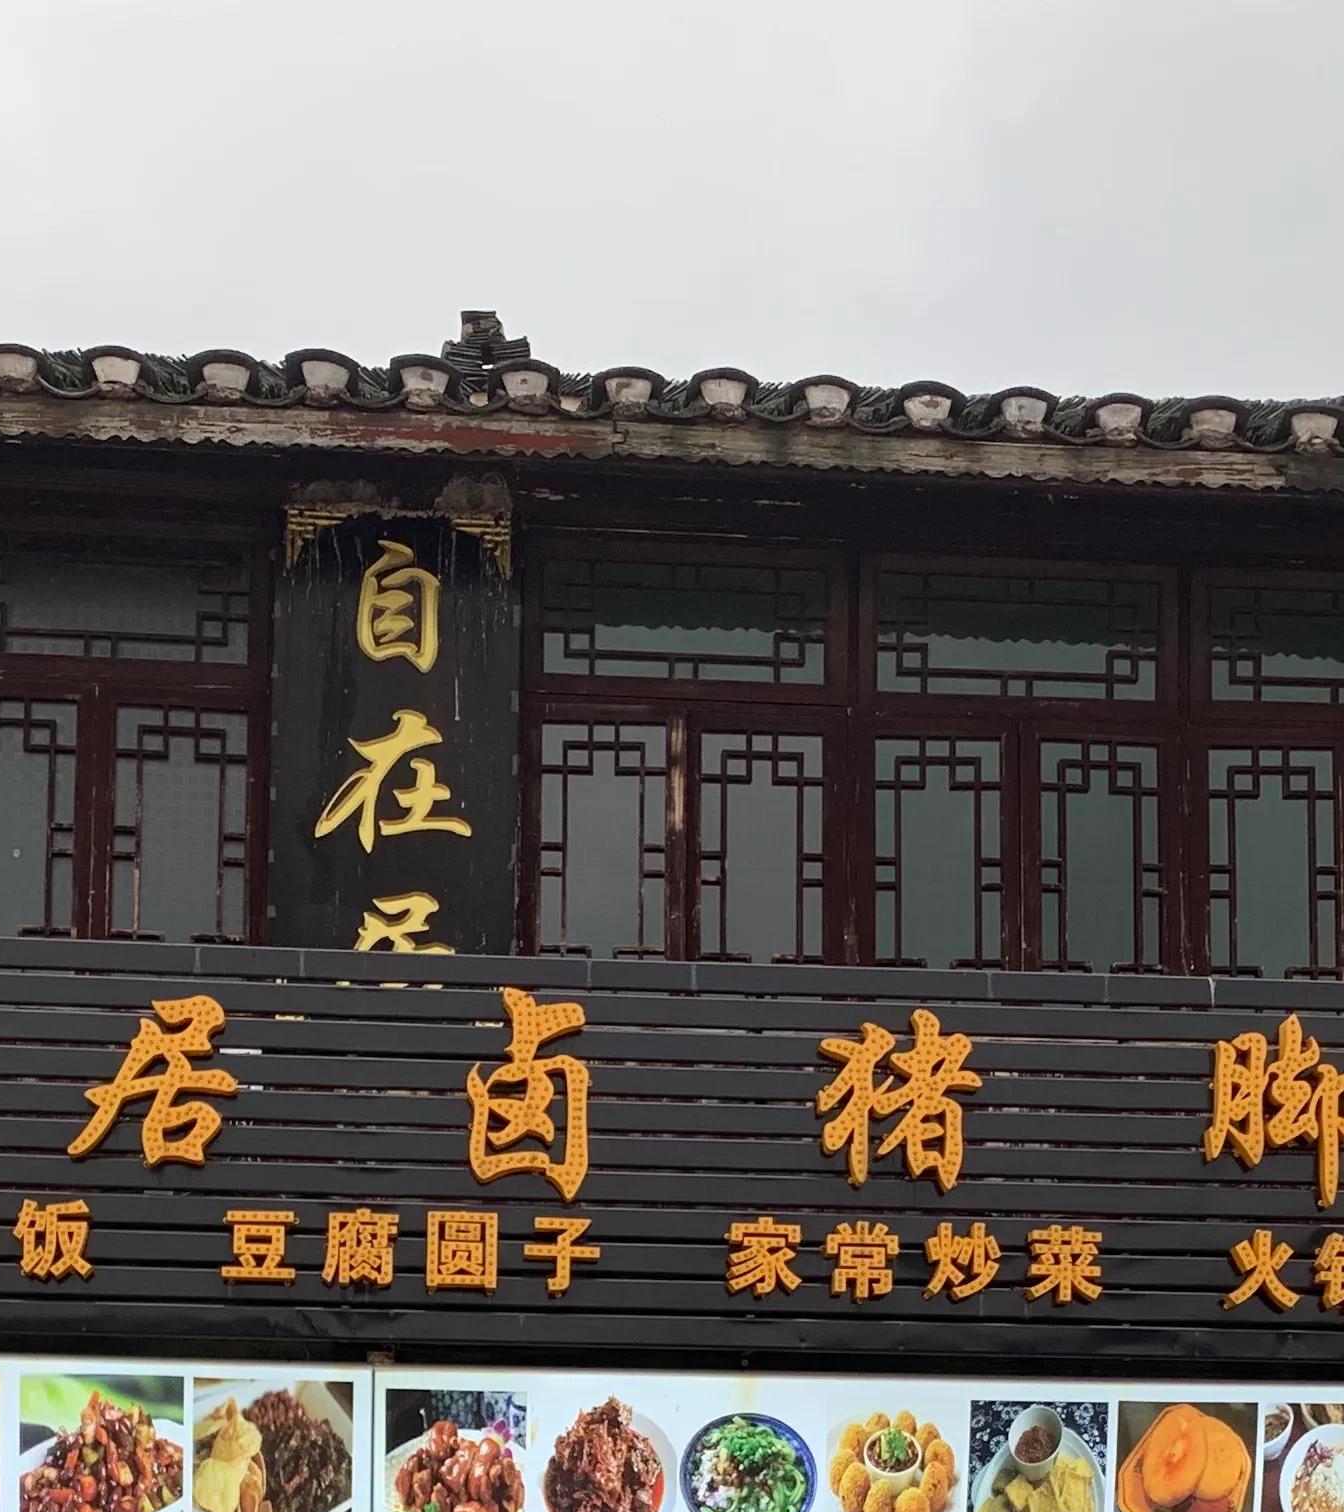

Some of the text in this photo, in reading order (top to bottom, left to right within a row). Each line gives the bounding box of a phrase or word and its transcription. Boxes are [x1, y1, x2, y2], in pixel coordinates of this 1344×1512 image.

[220, 1207, 601, 1298] 豆腐圆子
[724, 1216, 1104, 1305] 家常炒菜
